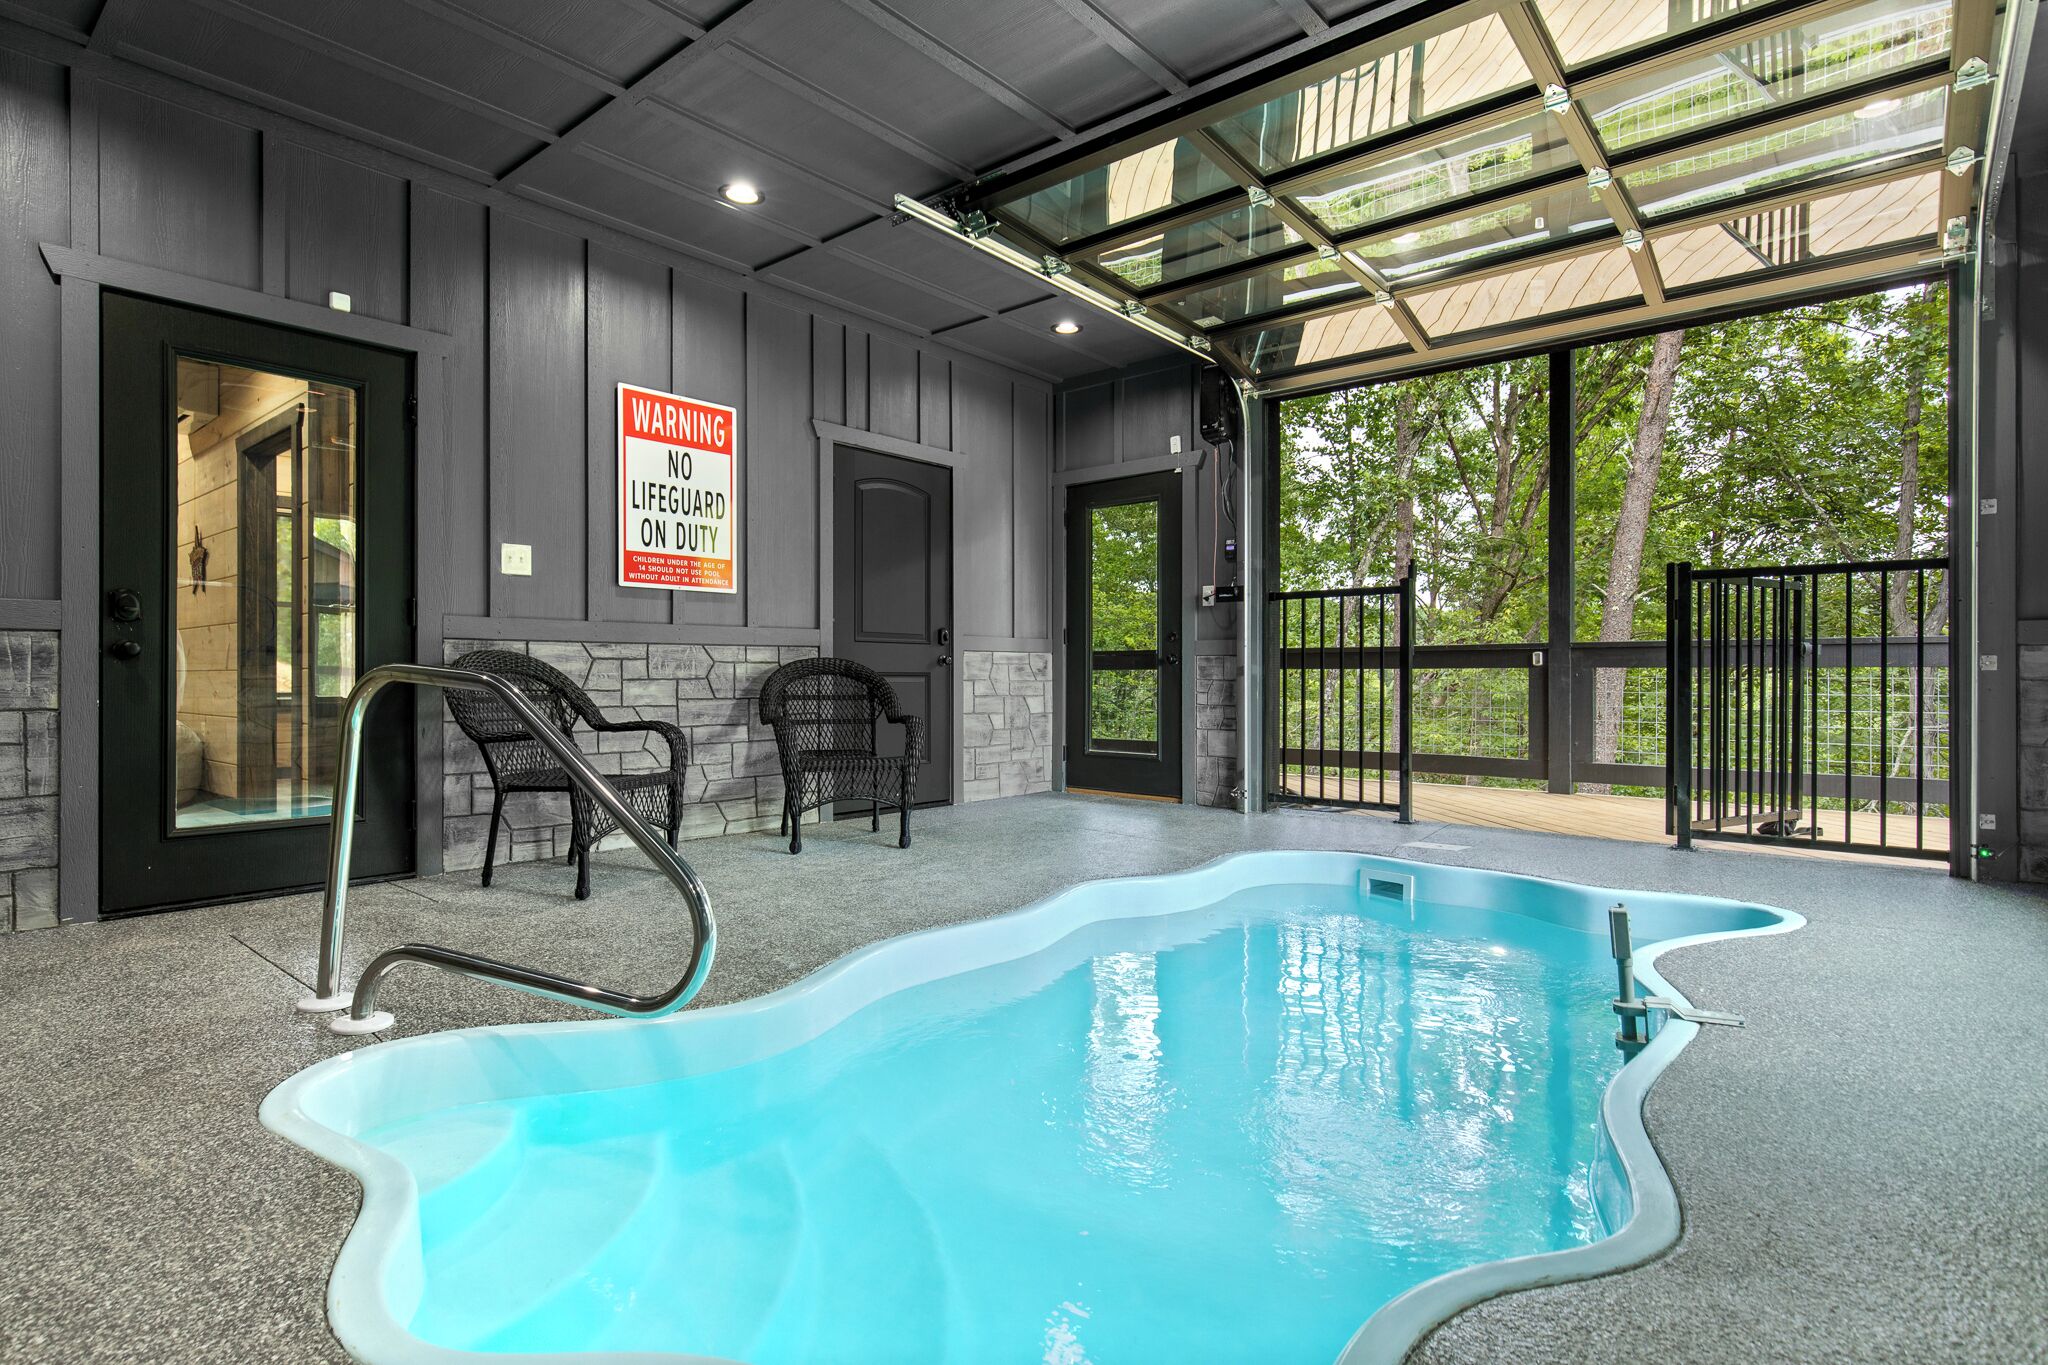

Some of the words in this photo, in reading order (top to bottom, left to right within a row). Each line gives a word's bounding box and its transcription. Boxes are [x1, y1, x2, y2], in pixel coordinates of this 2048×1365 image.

[632, 398, 725, 447] WARNING
[668, 450, 692, 480] NO
[633, 480, 725, 519] LIFEGUARD
[641, 518, 665, 548] ON
[677, 522, 718, 553] DUTY
[633, 556, 664, 564] CHILDREN
[648, 565, 673, 573] SHOULD
[692, 577, 728, 586] ATTENDANCE
